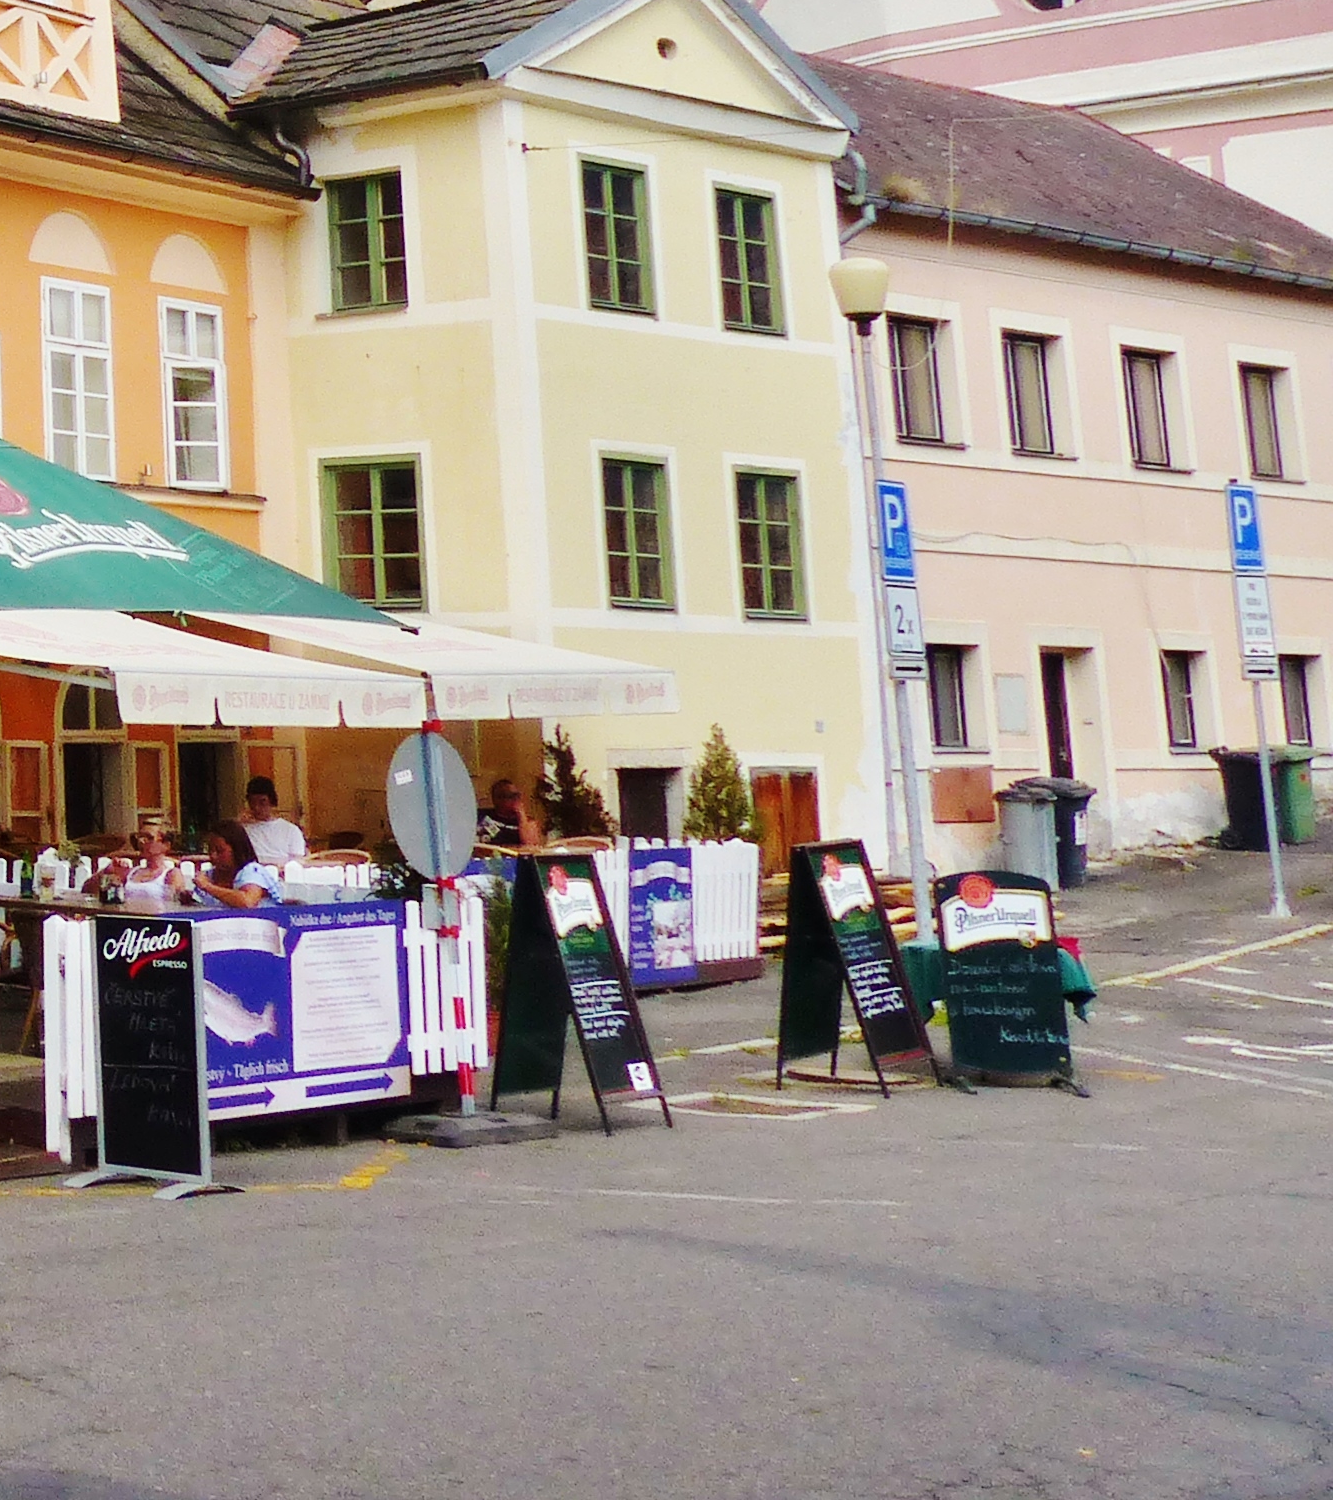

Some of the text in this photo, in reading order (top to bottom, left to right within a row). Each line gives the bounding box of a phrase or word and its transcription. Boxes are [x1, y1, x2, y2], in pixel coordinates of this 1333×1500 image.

[41, 508, 187, 560] Urquell
[883, 494, 904, 549] P
[1234, 496, 1252, 544] P
[955, 907, 1036, 934] Pilsner Urquell
[103, 924, 181, 964] Alfredo
[152, 959, 188, 970] ESPRESSO
